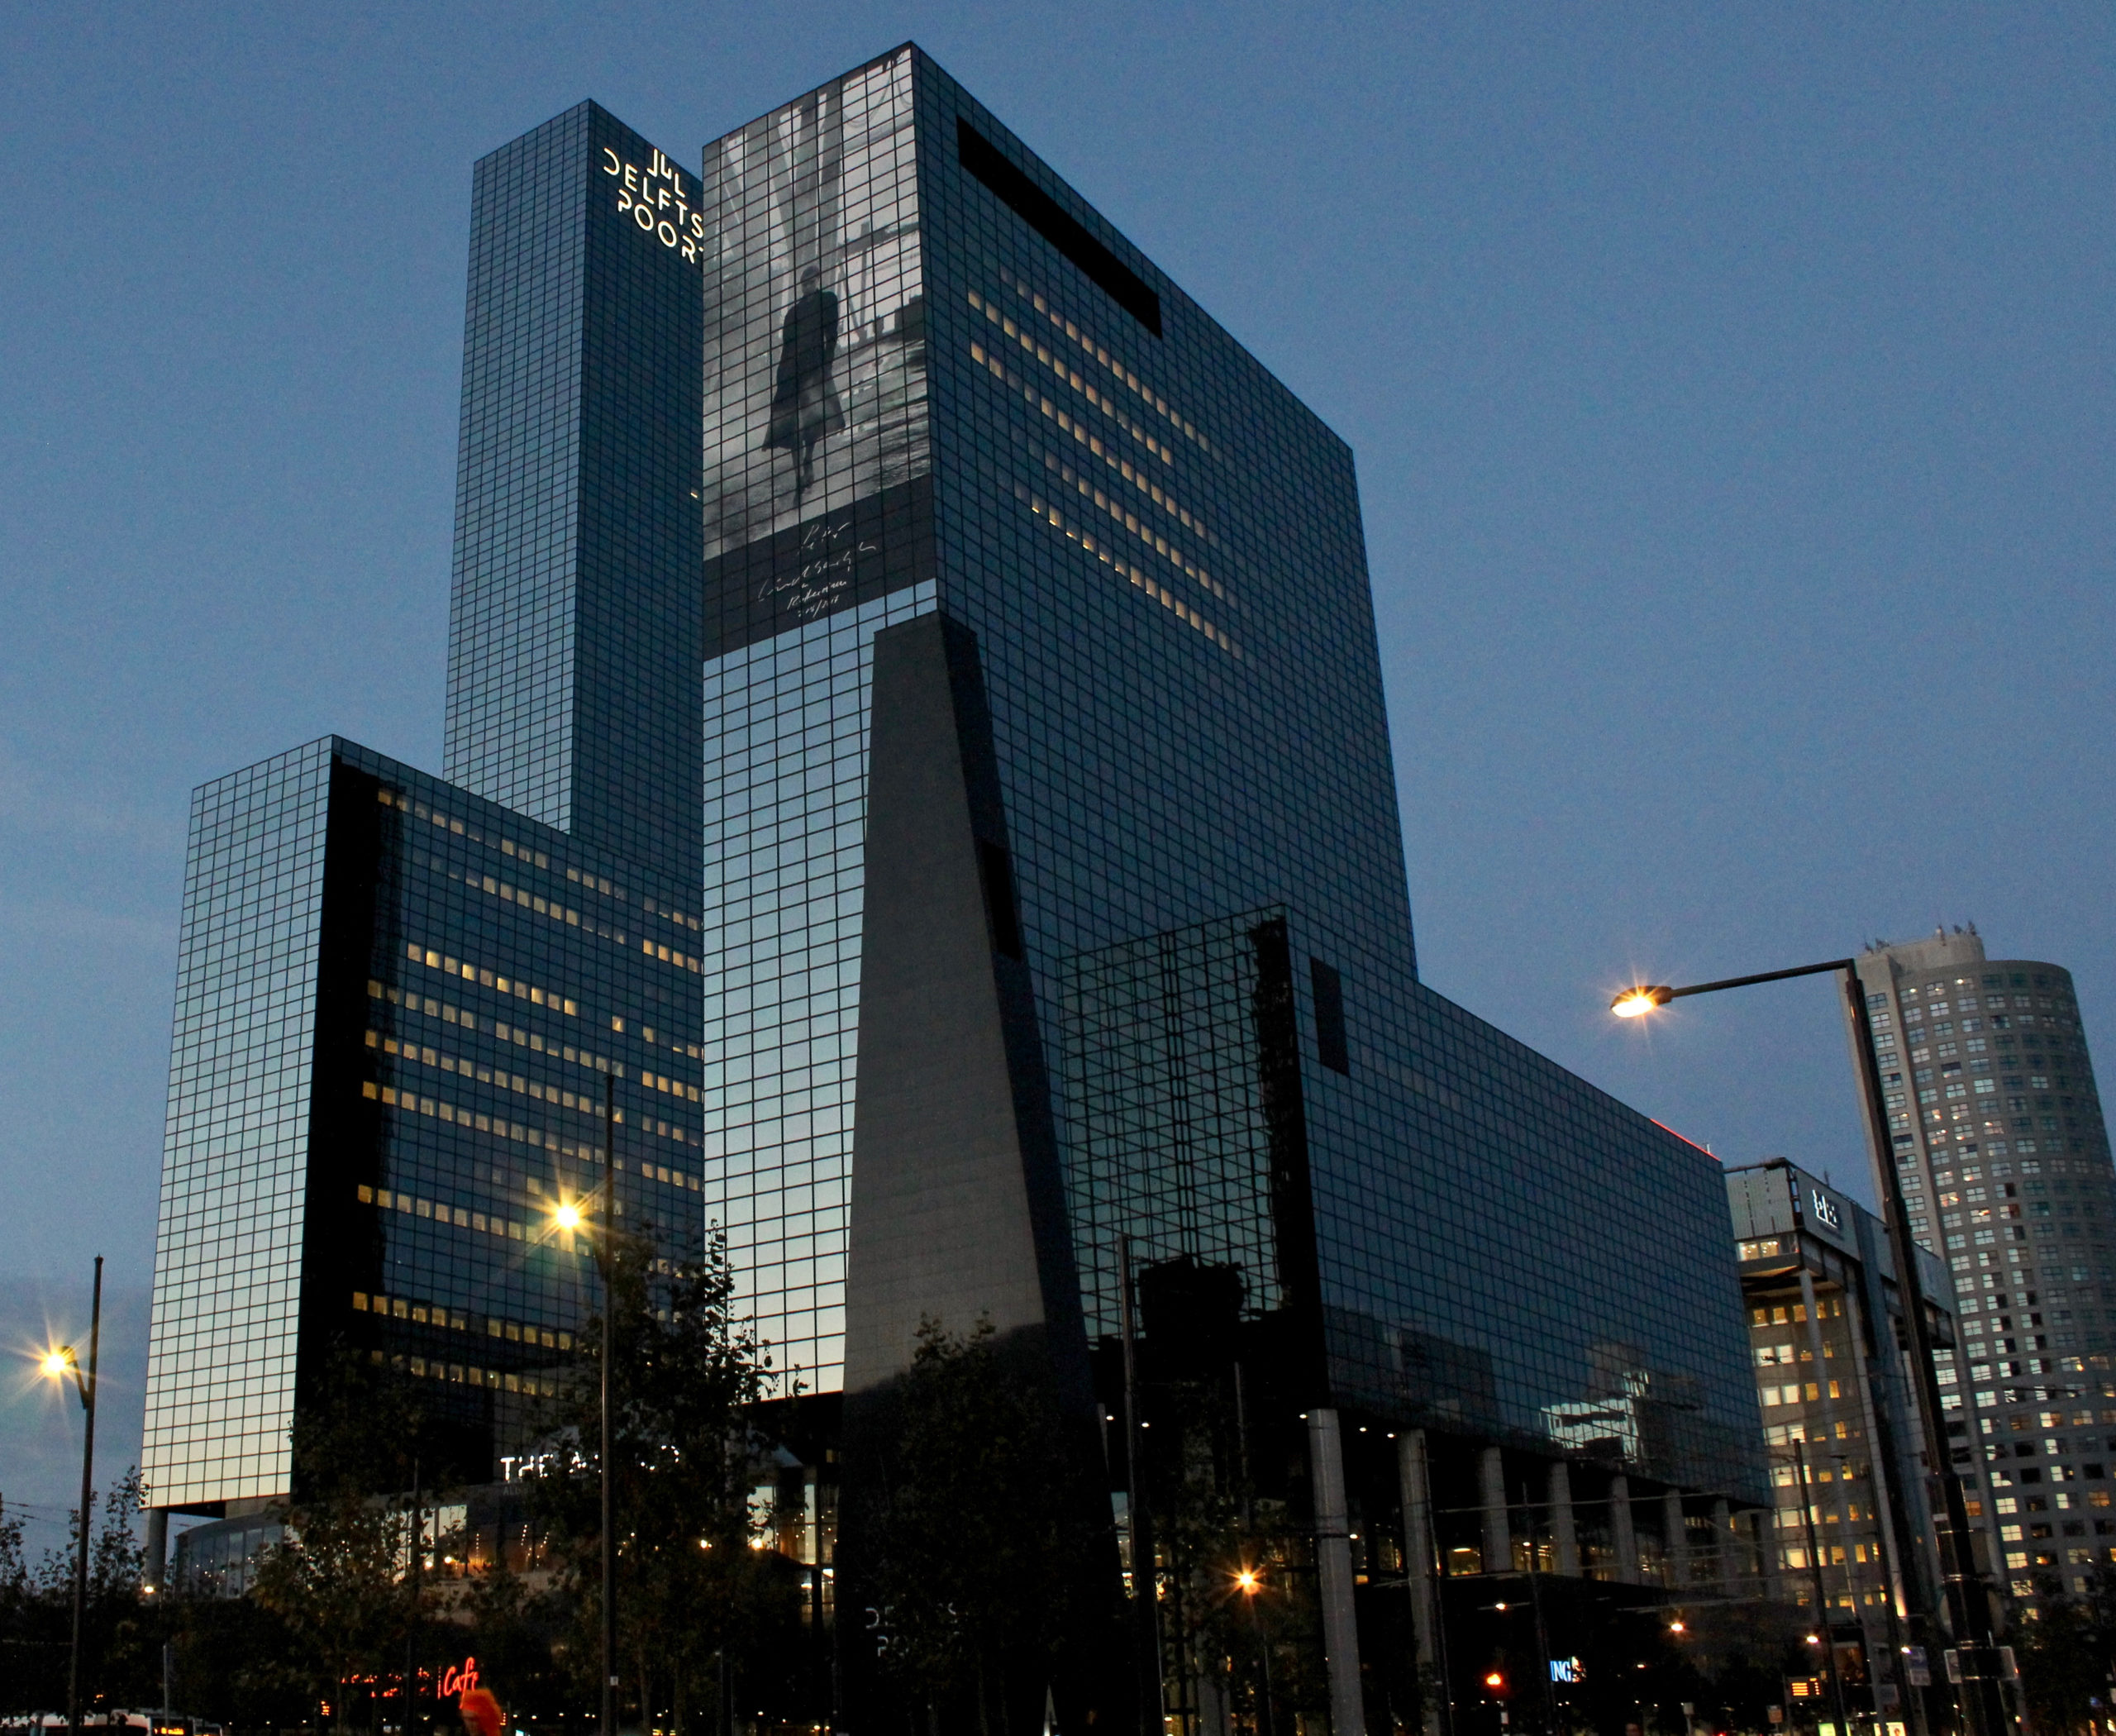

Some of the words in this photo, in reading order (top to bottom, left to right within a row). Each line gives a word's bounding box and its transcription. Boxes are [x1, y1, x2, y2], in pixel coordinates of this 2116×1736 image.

[617, 189, 704, 265] POOR
[499, 1453, 553, 1481] THE
[1551, 1661, 1572, 1681] ING
